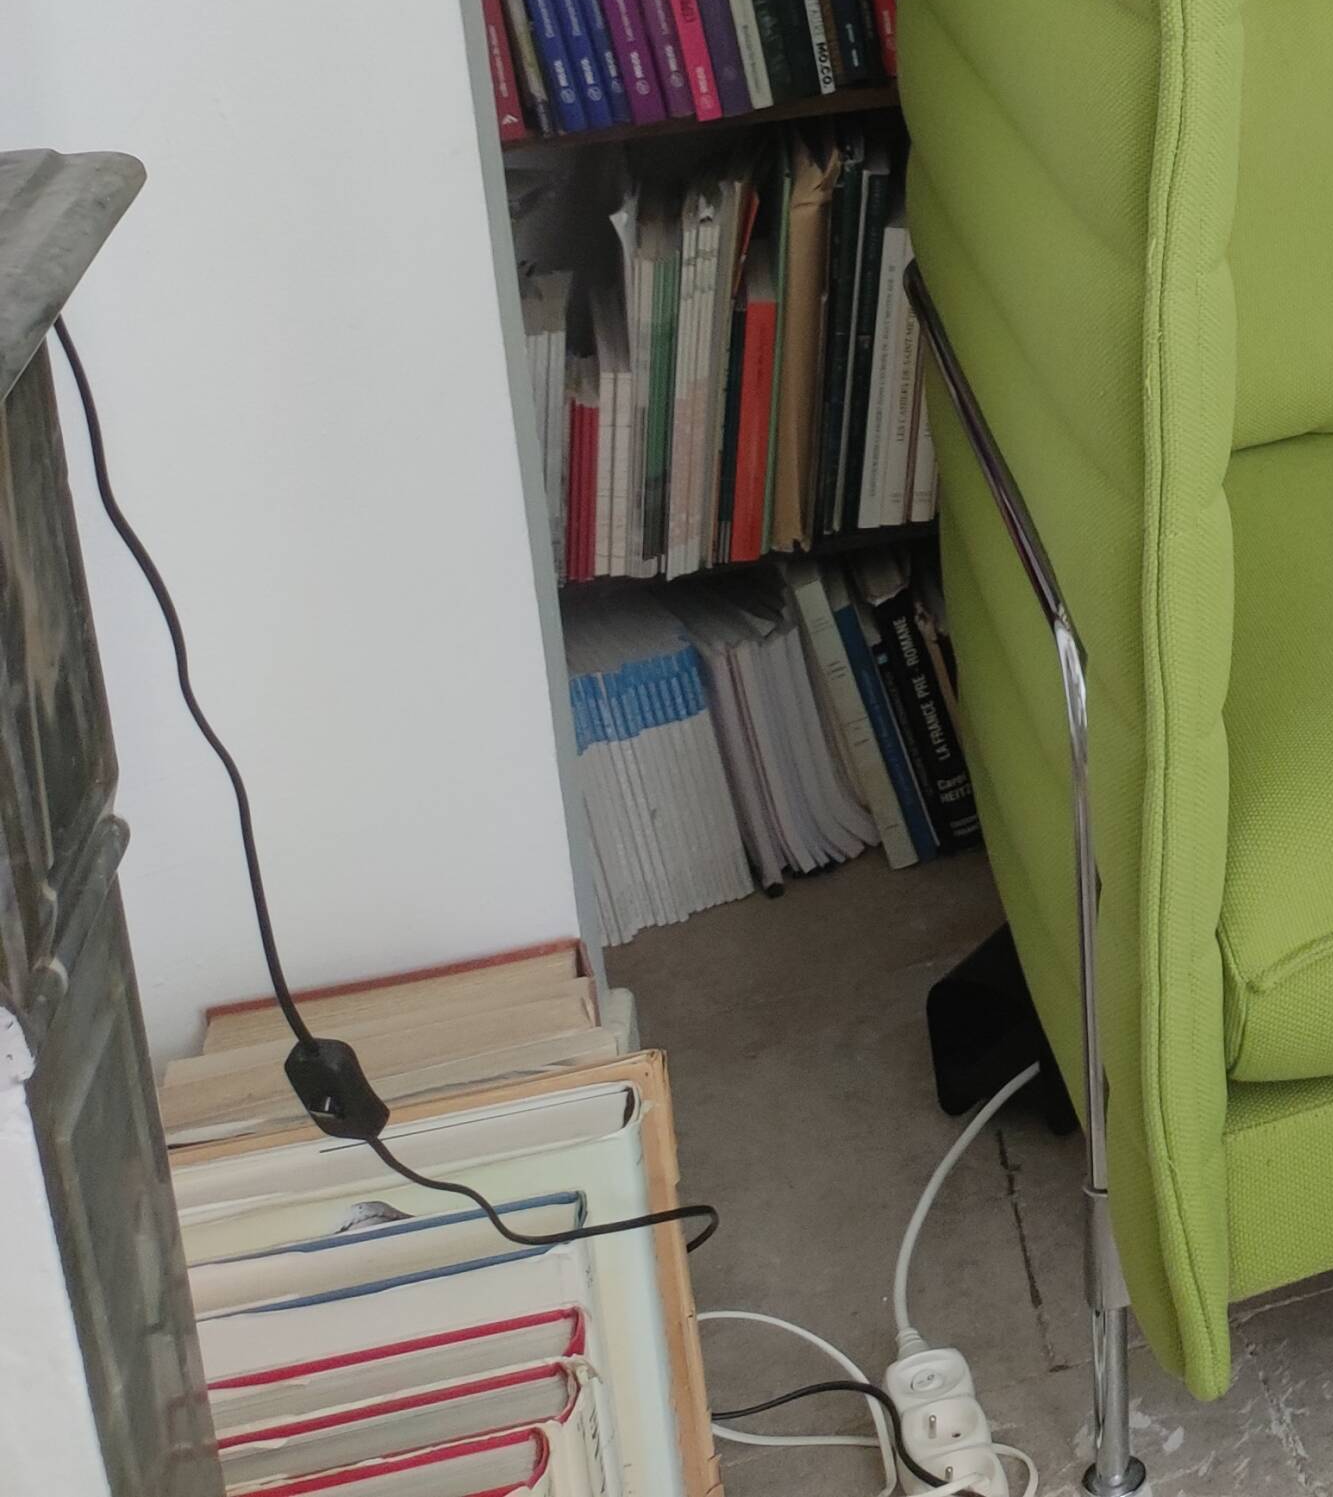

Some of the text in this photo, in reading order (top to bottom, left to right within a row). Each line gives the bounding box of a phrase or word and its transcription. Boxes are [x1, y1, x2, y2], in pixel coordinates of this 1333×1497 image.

[816, 41, 833, 90] MO.CO.
[893, 616, 920, 667] ROMANE
[921, 701, 945, 744] FRANCE
[937, 745, 951, 760] LA
